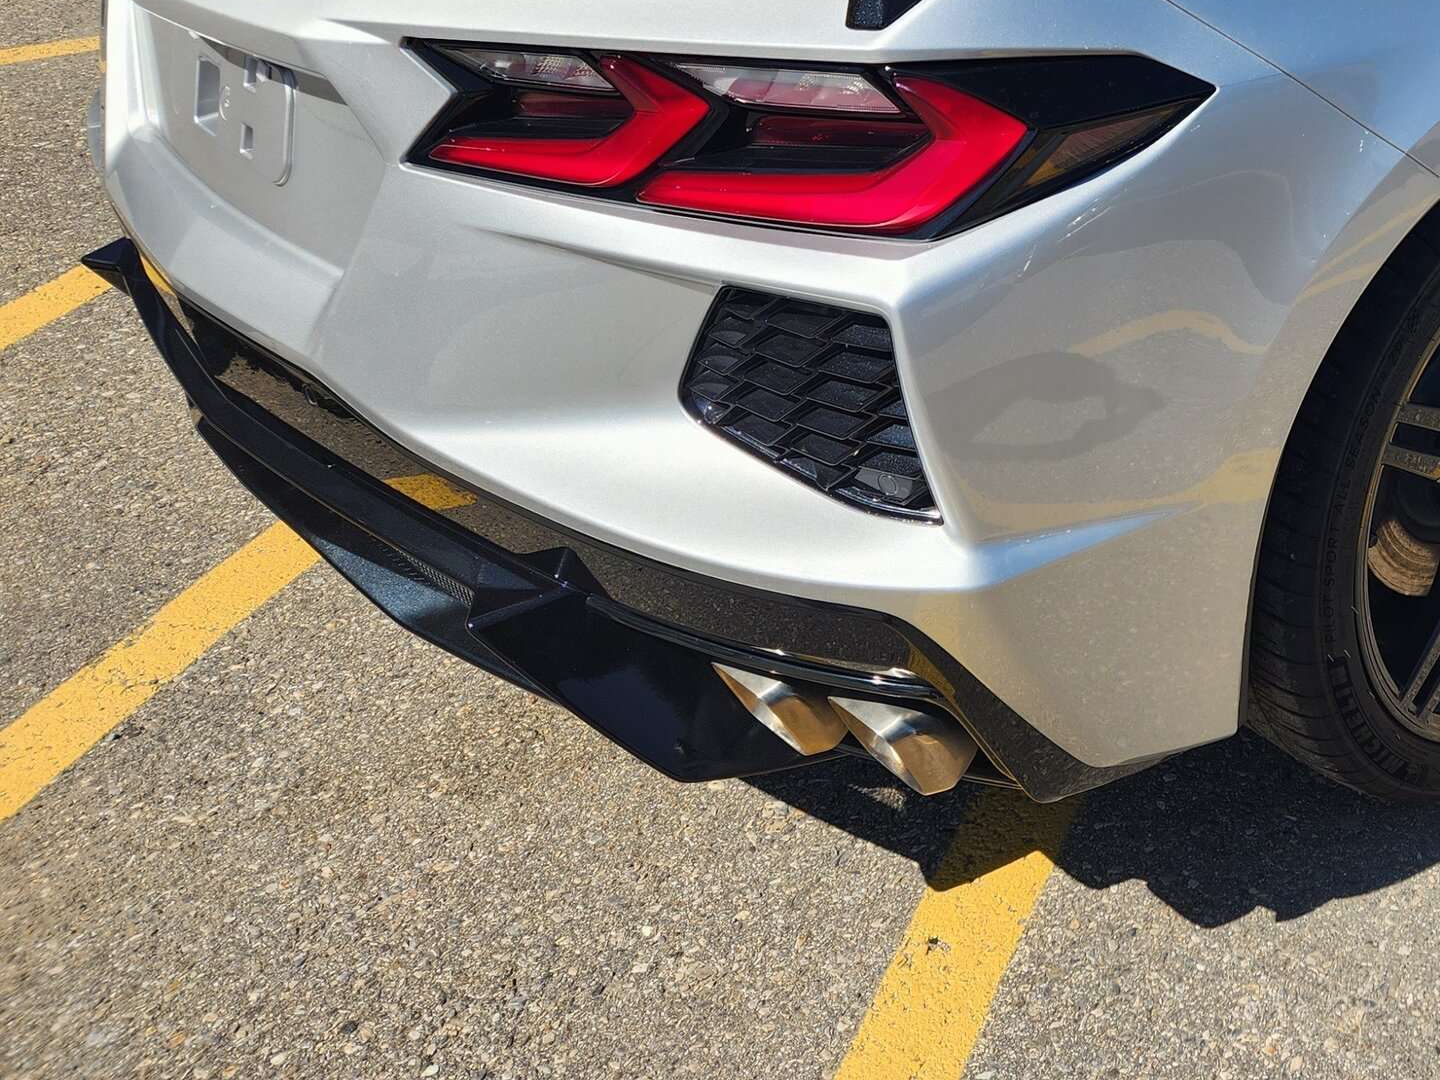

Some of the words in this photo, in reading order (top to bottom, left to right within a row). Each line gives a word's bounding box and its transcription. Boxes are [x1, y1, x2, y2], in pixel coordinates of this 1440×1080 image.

[1344, 388, 1382, 470] SEASON
[1323, 525, 1341, 588] SPORT
[1323, 595, 1338, 644] PILOT
